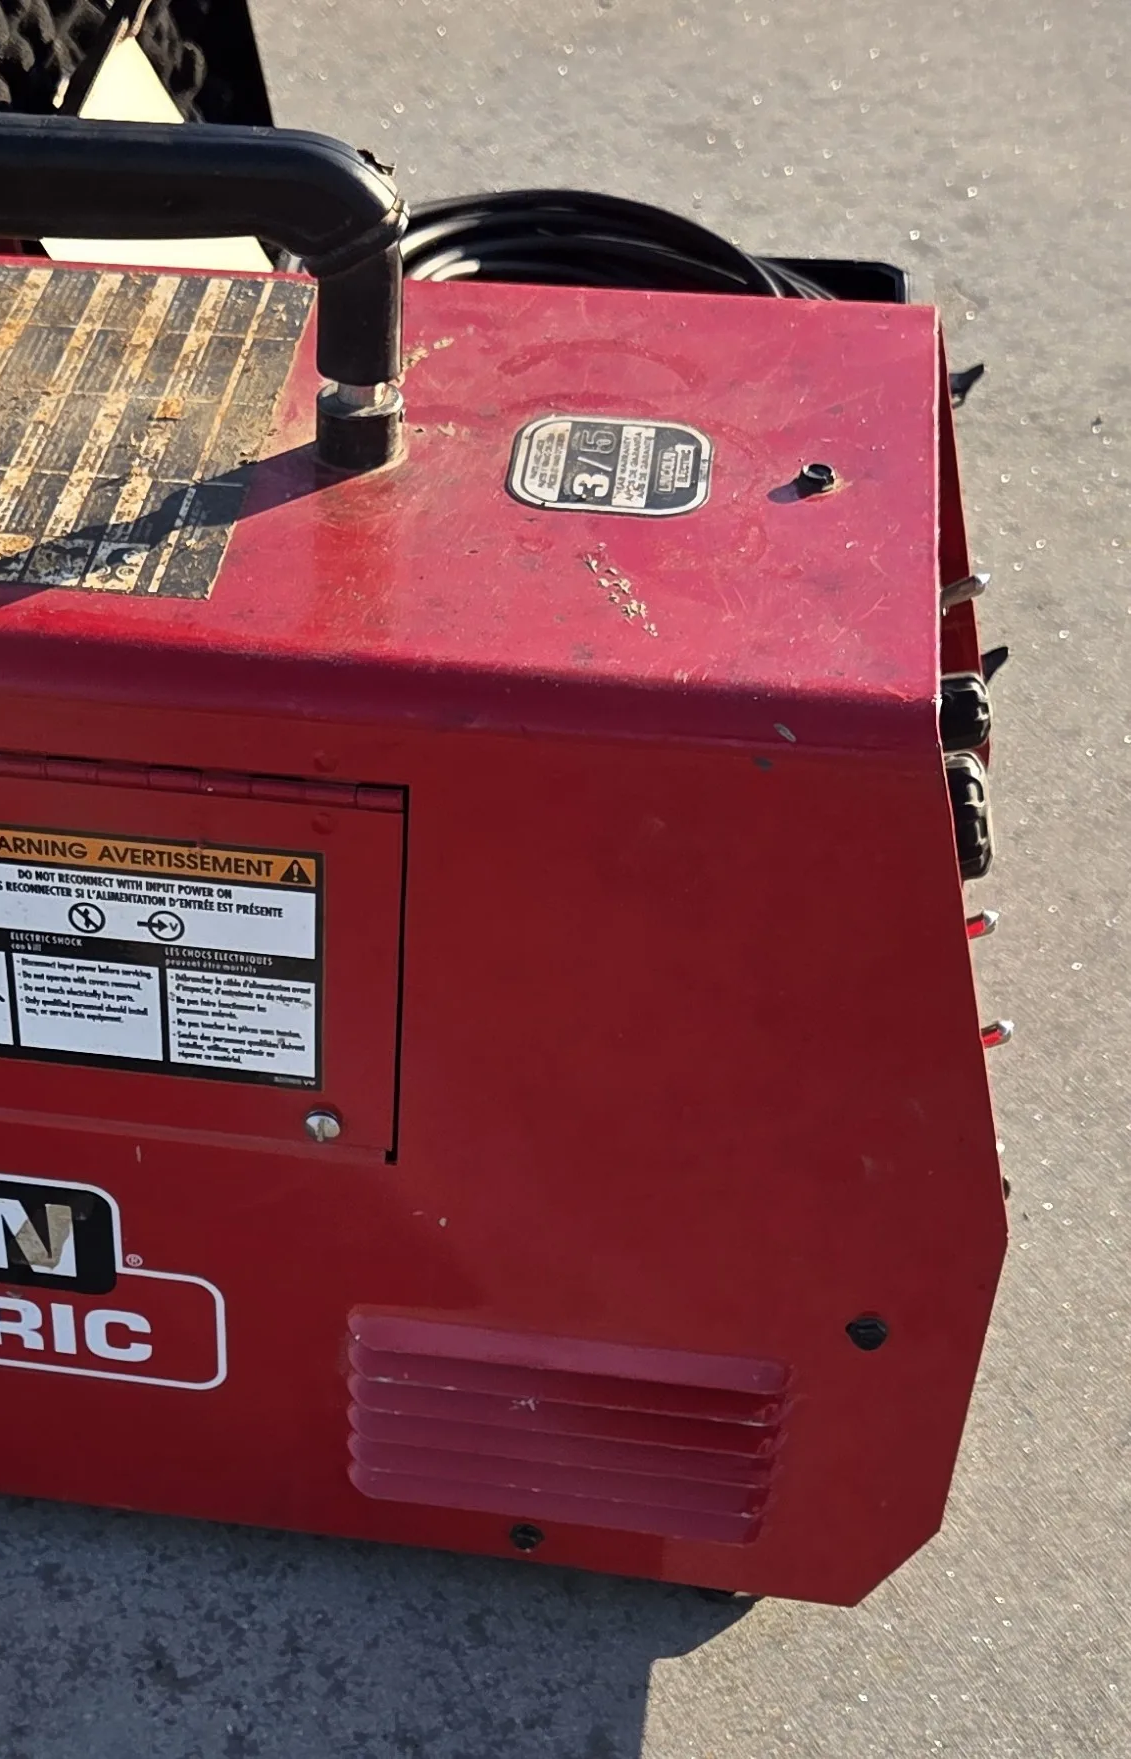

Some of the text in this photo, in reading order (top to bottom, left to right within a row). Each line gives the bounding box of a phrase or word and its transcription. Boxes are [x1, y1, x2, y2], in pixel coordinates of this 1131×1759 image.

[98, 845, 274, 877] AVERTISSEMENT
[17, 869, 232, 899] DO NOT RECONNECT WITH INPUT POWER ON
[6, 881, 72, 898] RECONNECTER
[74, 889, 85, 899] SI
[217, 903, 234, 914] EST
[235, 902, 284, 918] PRÉSENTE
[10, 931, 83, 947] ELECTRIC SHOCK
[164, 947, 180, 957] LES
[182, 948, 213, 960] CHOCS
